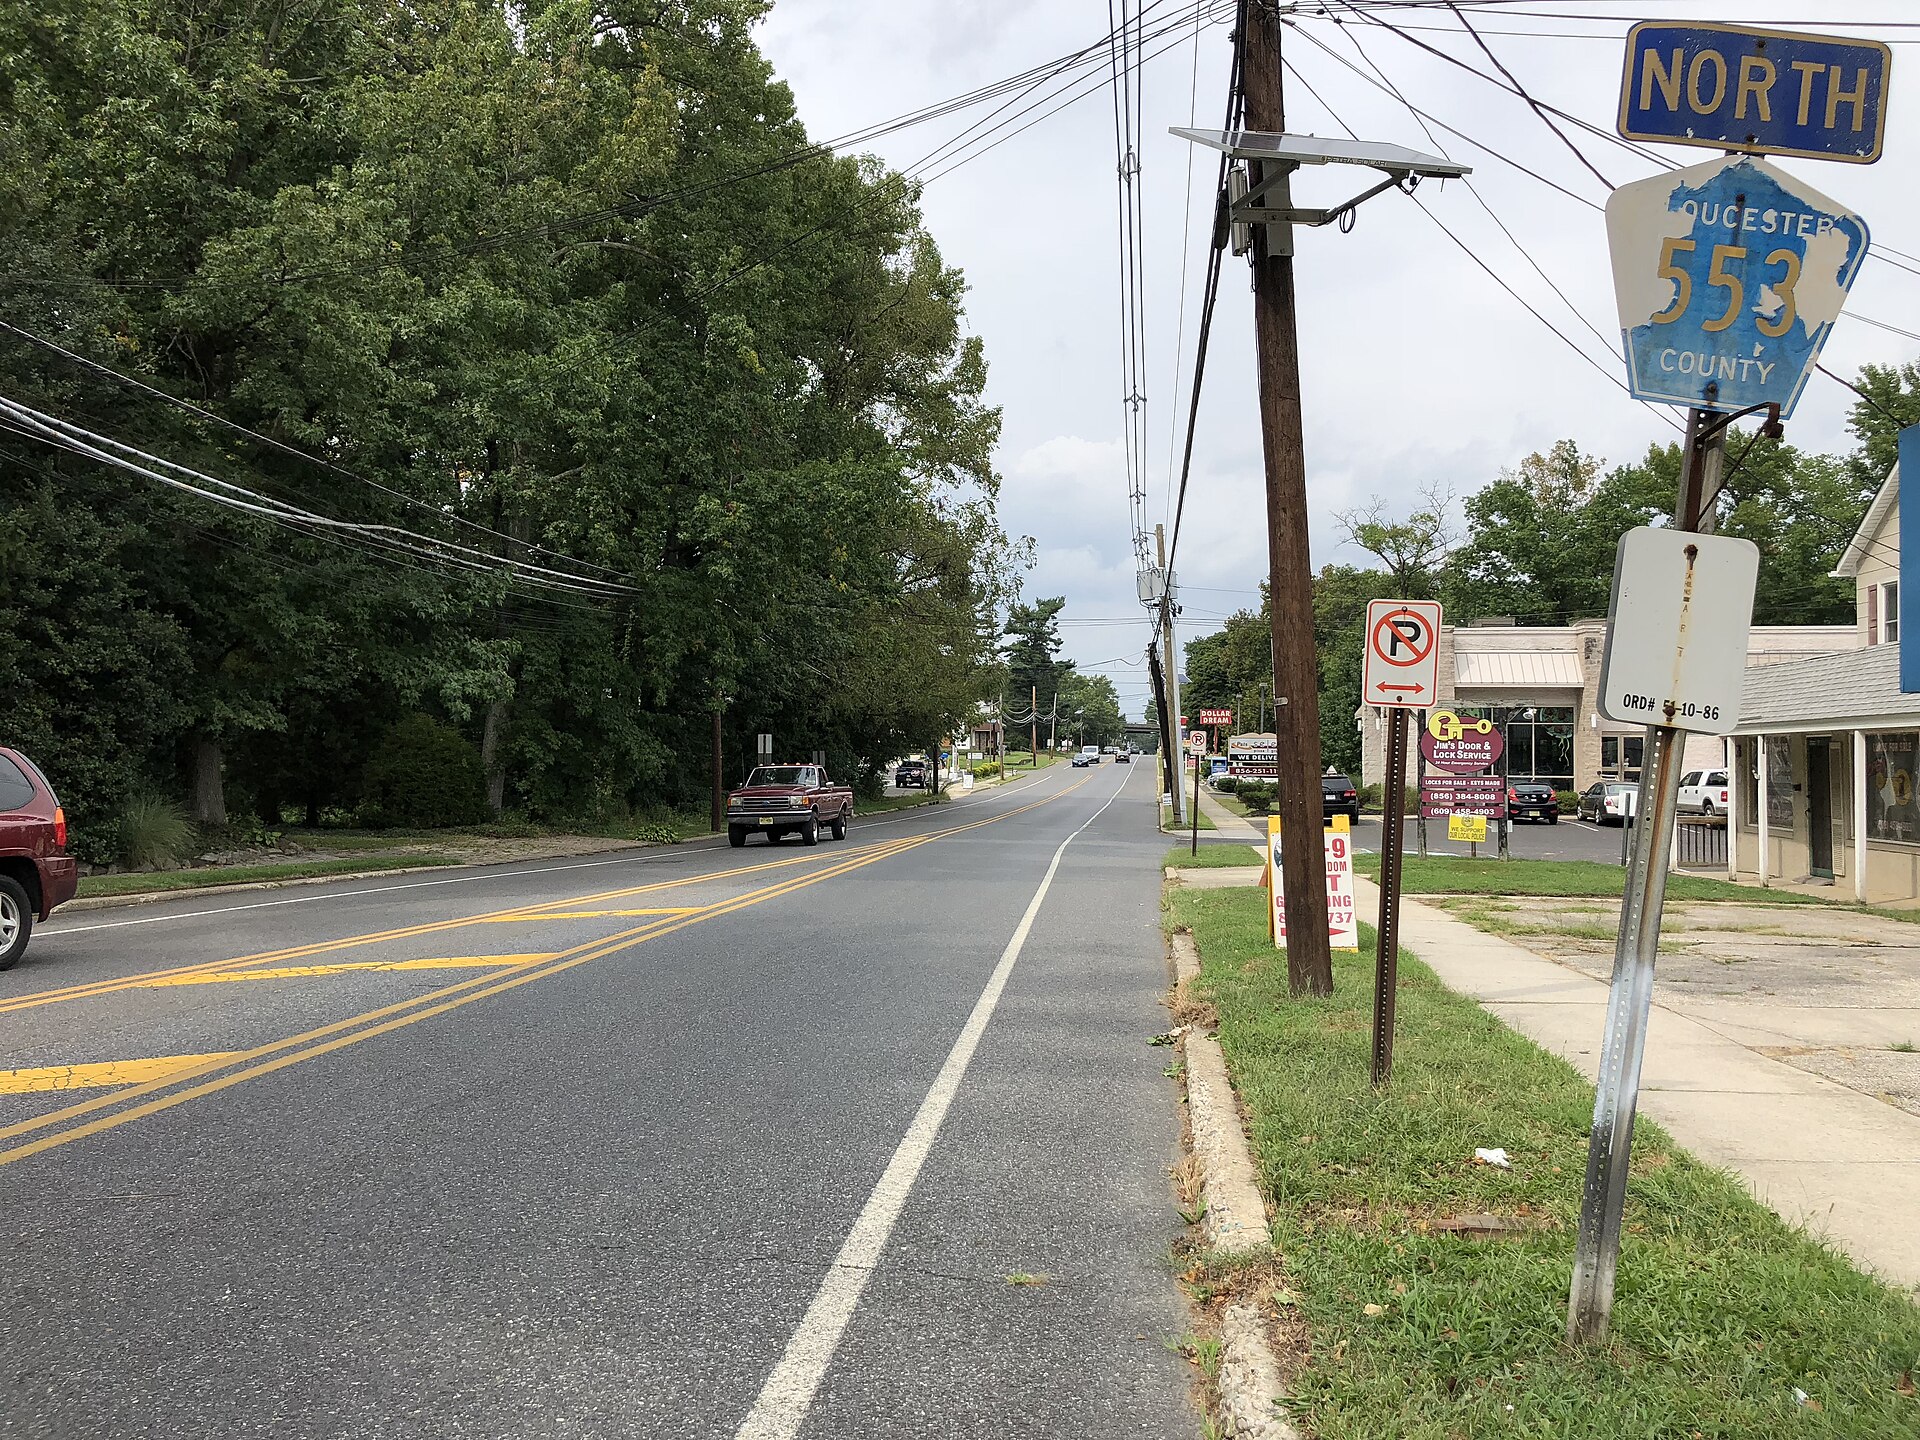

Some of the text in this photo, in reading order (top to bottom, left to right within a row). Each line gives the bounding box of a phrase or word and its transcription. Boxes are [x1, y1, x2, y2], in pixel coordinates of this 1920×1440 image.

[1639, 48, 1868, 132] NORTH
[1681, 199, 1834, 238] OUCESTER
[1650, 236, 1800, 338] 553
[1659, 348, 1776, 385] COUNTY
[1623, 693, 1656, 712] ORD#
[1457, 750, 1492, 760] SERVICE
[1483, 741, 1491, 750] &
[1430, 793, 1453, 801] (856)
